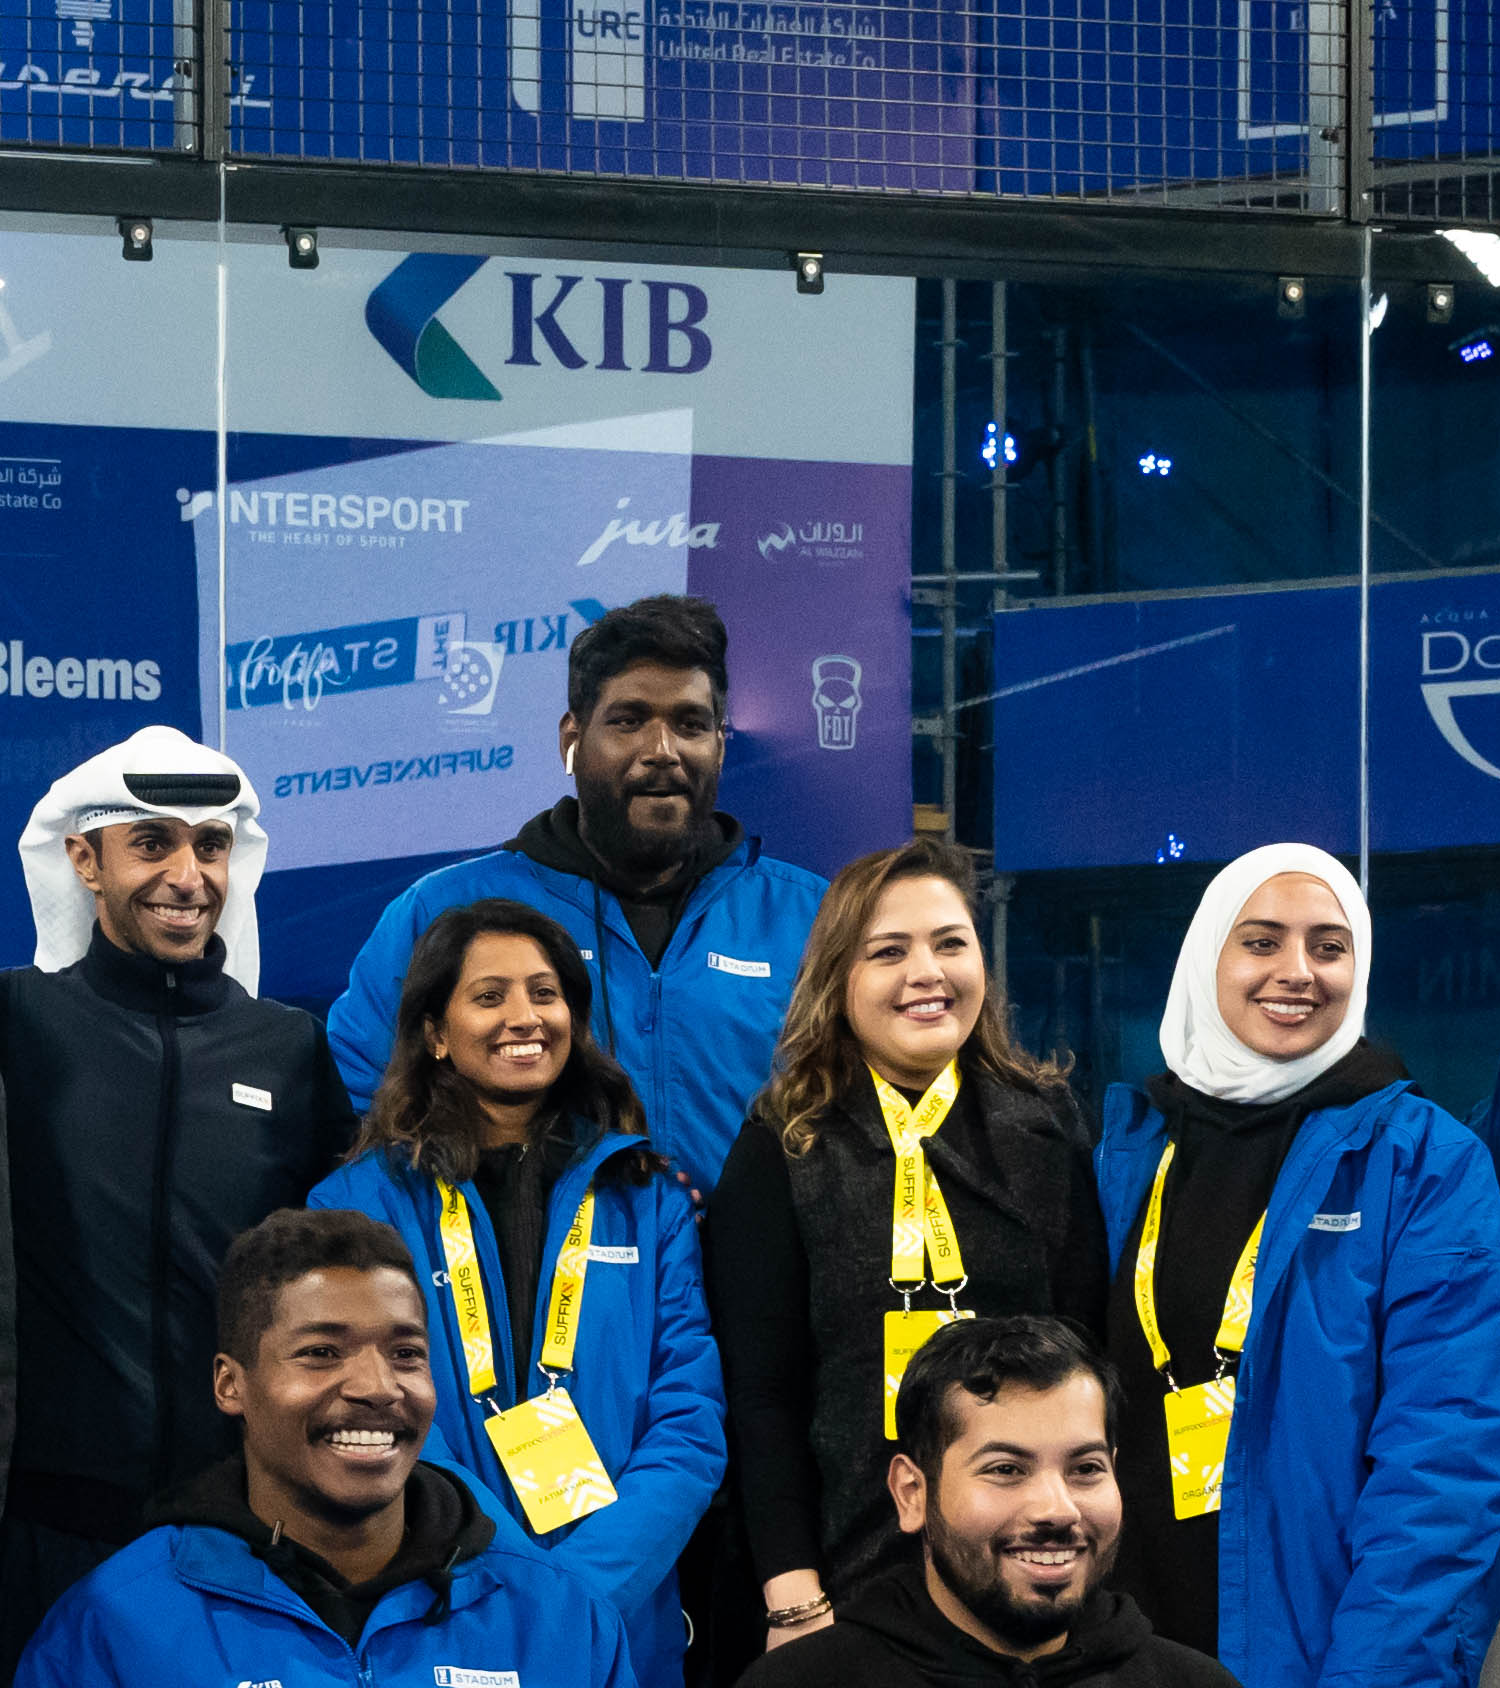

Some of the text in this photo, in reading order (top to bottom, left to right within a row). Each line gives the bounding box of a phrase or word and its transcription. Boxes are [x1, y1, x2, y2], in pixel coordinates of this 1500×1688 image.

[577, 10, 640, 40] URC
[660, 41, 731, 61] United
[736, 45, 776, 64] Real
[782, 47, 846, 68] Estate
[503, 271, 714, 375] KIB
[18, 466, 62, 488] شركة
[42, 492, 62, 510] Co
[221, 489, 470, 533] NTERSPORT
[250, 530, 276, 544] THE
[283, 532, 330, 546] HEART
[360, 535, 407, 549] SPORT
[576, 497, 722, 566] jura
[1420, 608, 1488, 625] ACQUA
[824, 714, 851, 741] FDT
[903, 1156, 916, 1209] SUFFIX
[458, 1267, 480, 1323] SUFFIX
[554, 1292, 575, 1347] SUFFIX
[455, 1672, 514, 1687] STADIUM
